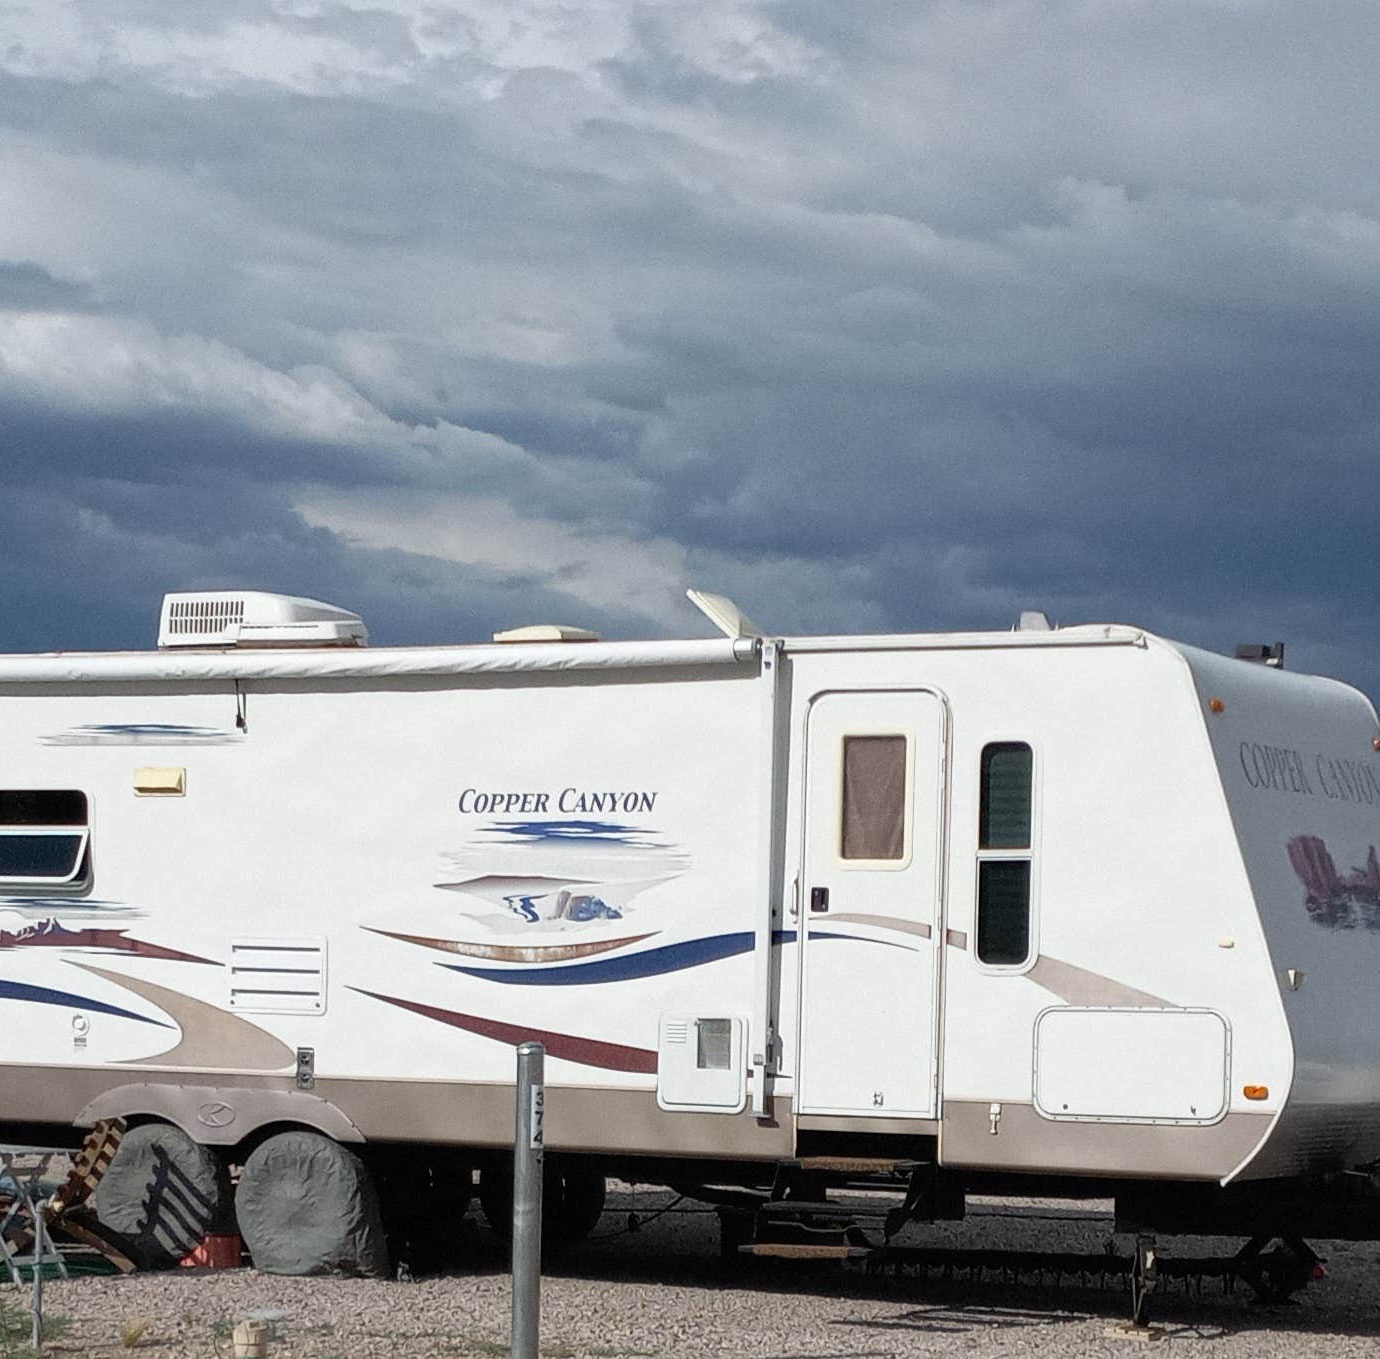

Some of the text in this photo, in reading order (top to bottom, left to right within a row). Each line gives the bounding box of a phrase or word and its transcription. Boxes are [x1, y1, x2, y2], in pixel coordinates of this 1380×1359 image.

[1239, 741, 1314, 796] COPPER
[458, 787, 659, 814] COPPER CANYON
[532, 1090, 544, 1146] 374
